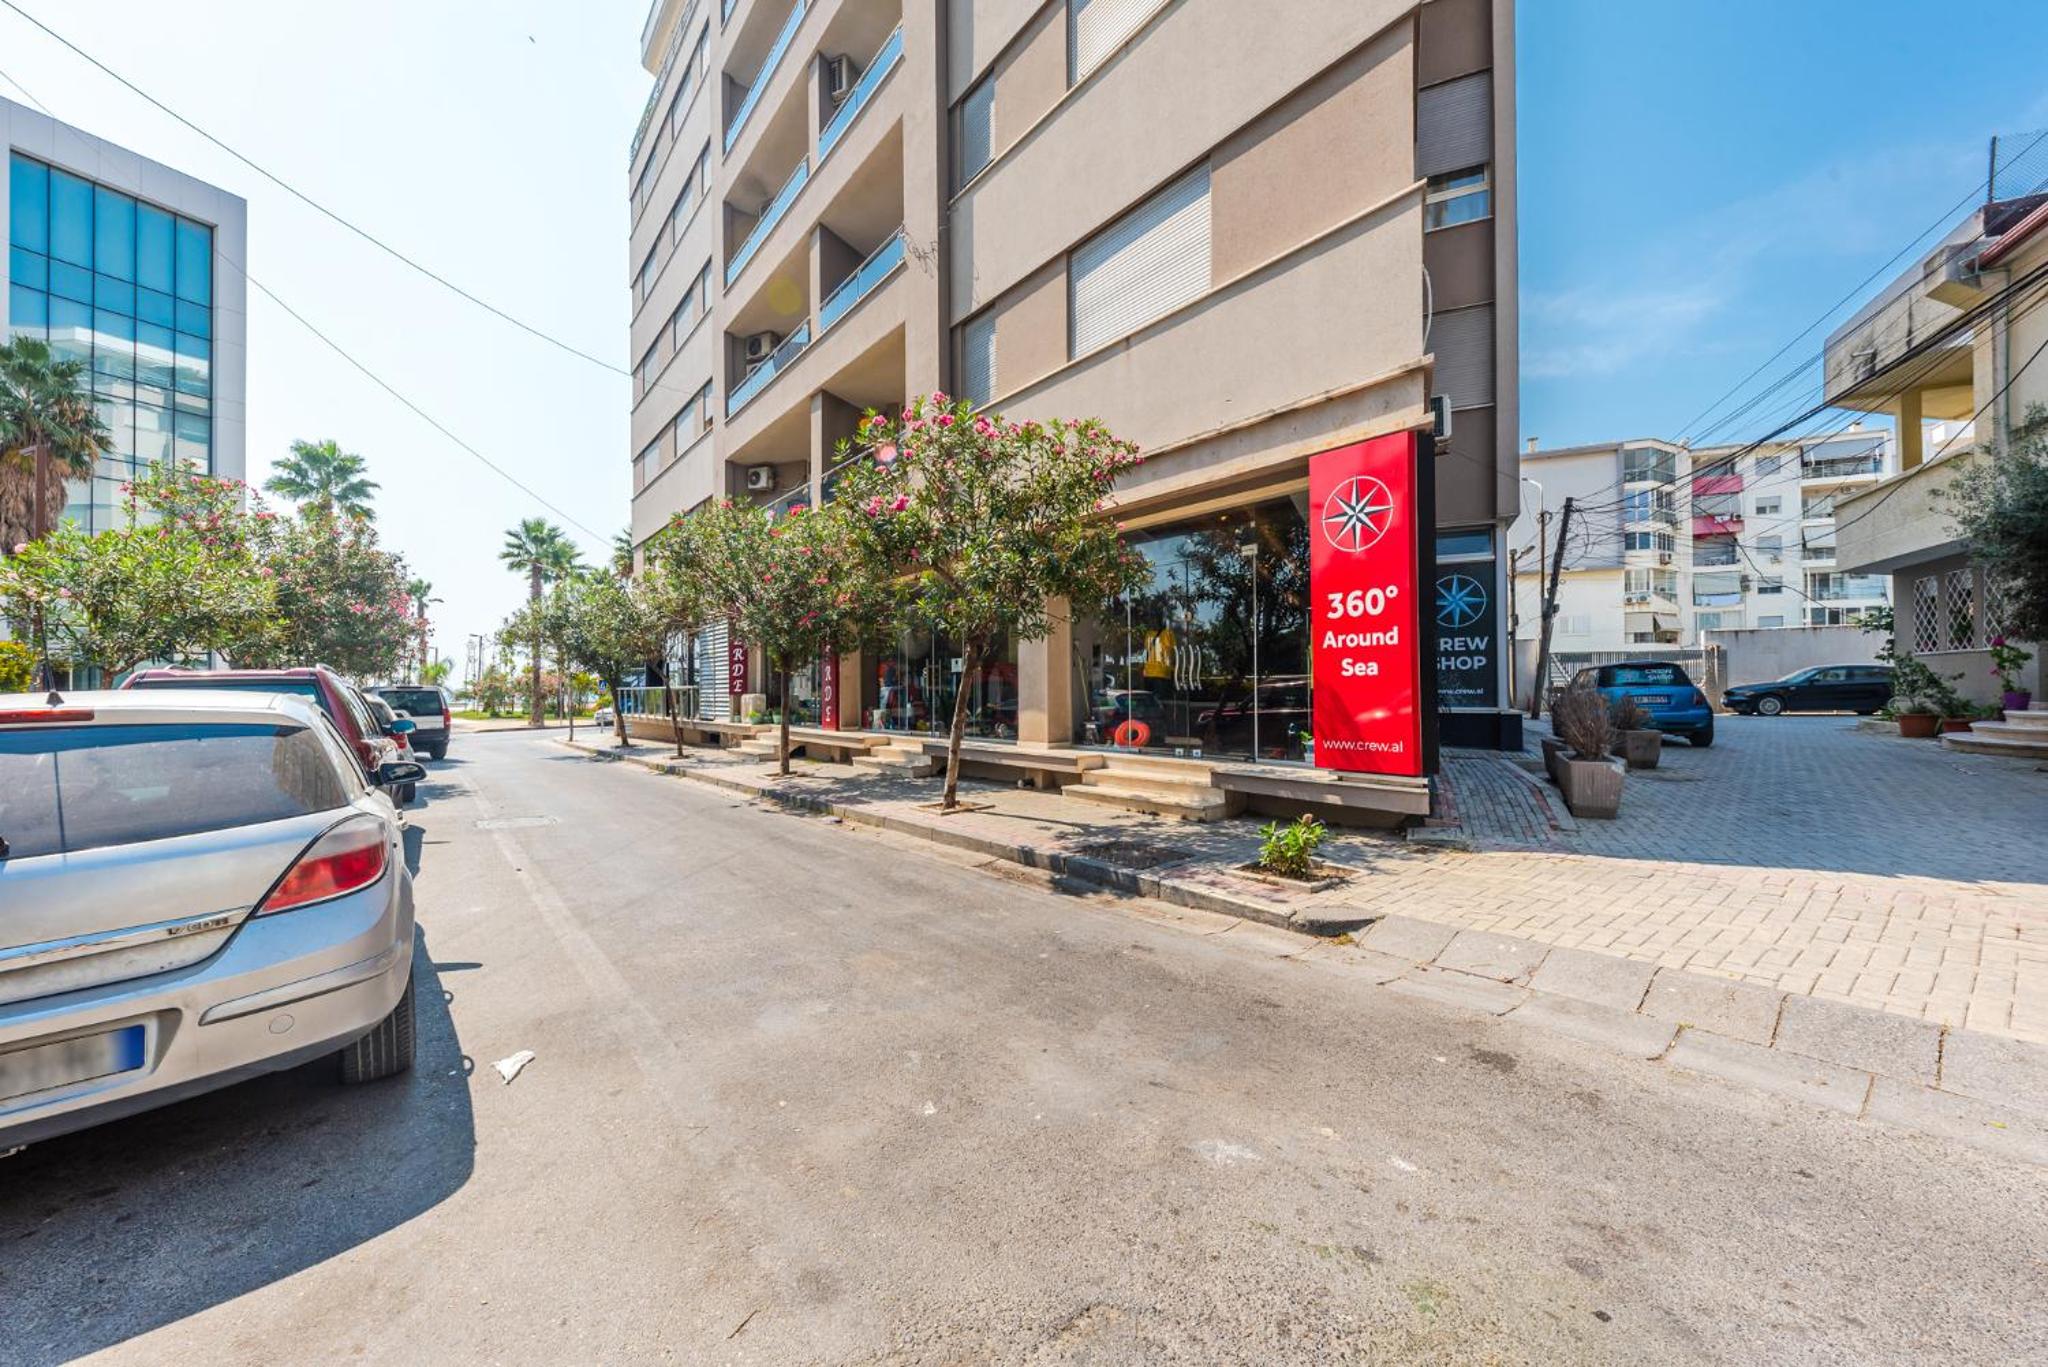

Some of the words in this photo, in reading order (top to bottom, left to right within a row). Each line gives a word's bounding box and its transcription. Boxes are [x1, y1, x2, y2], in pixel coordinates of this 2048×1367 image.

[1327, 585, 1398, 619] 360°
[1322, 625, 1399, 649] Around
[1439, 636, 1489, 651] REW
[1341, 657, 1379, 677] Sea
[1437, 656, 1487, 670] HOP
[1322, 739, 1404, 753] www.crew.al
